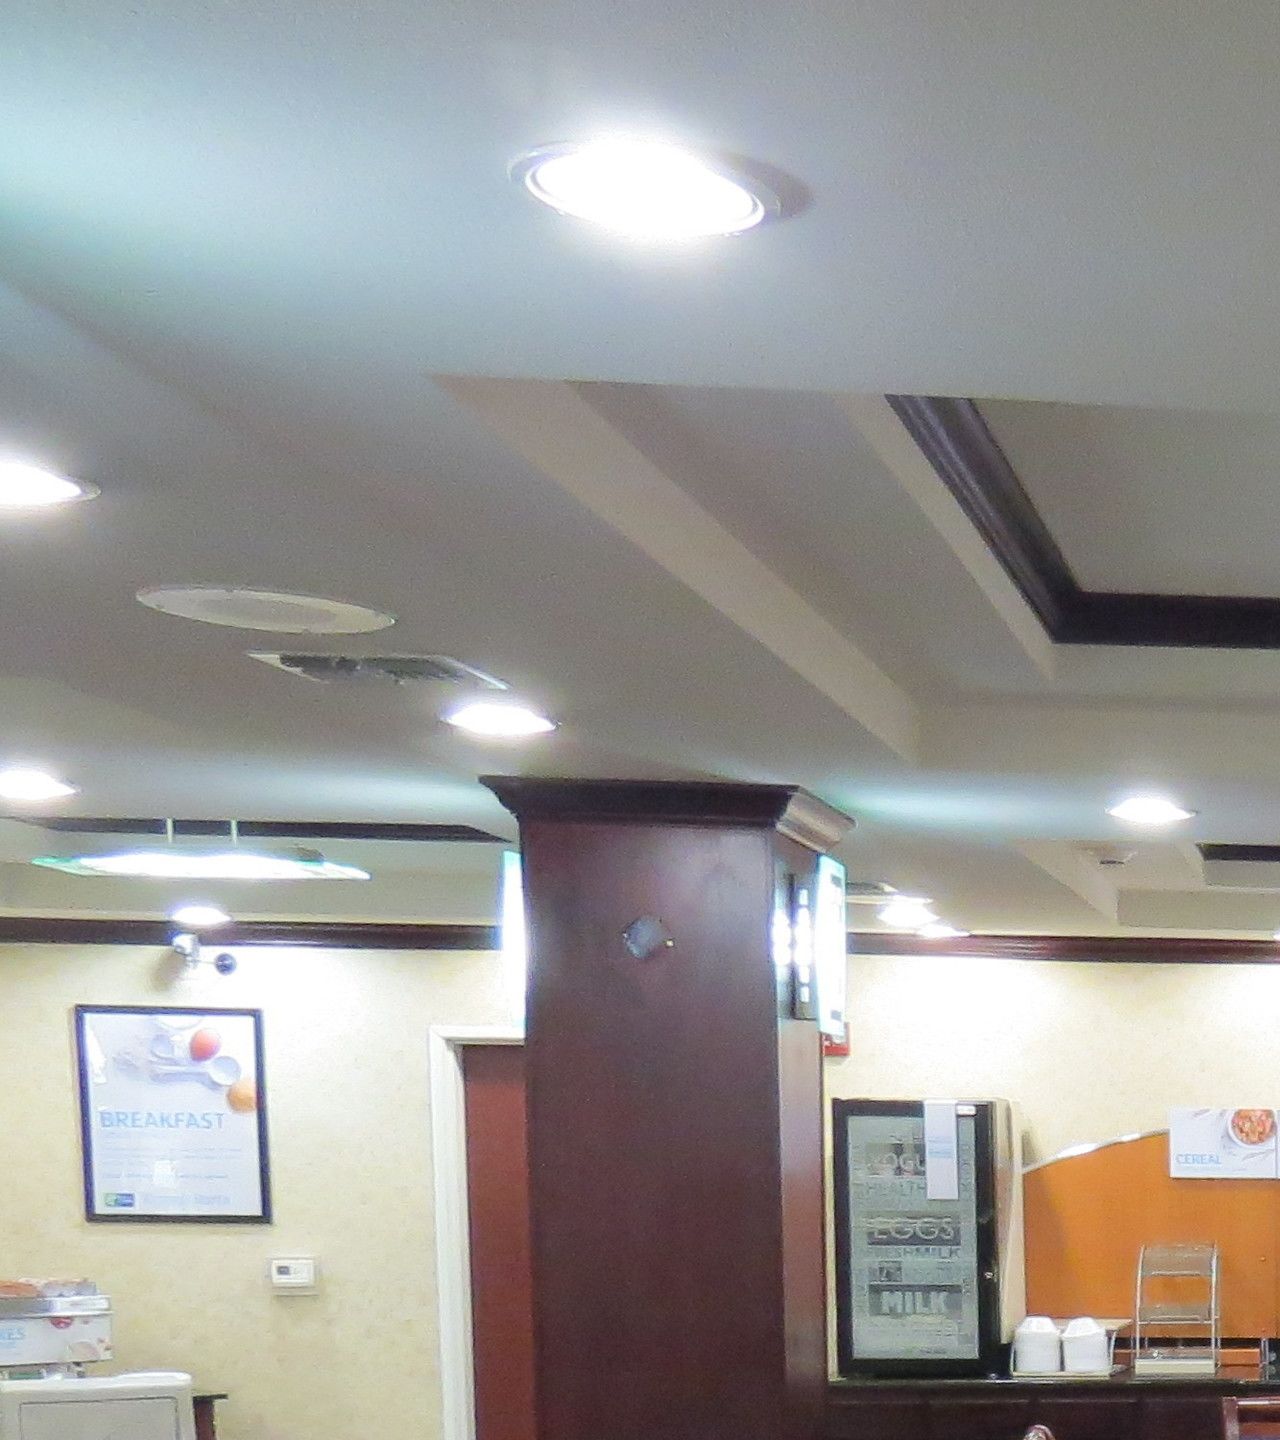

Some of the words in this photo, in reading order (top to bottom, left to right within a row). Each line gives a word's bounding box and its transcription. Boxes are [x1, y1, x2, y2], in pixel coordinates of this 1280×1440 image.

[99, 1111, 225, 1129] BREAKFAST
[1175, 1153, 1223, 1165] CEREAL
[880, 1291, 949, 1314] MILK
